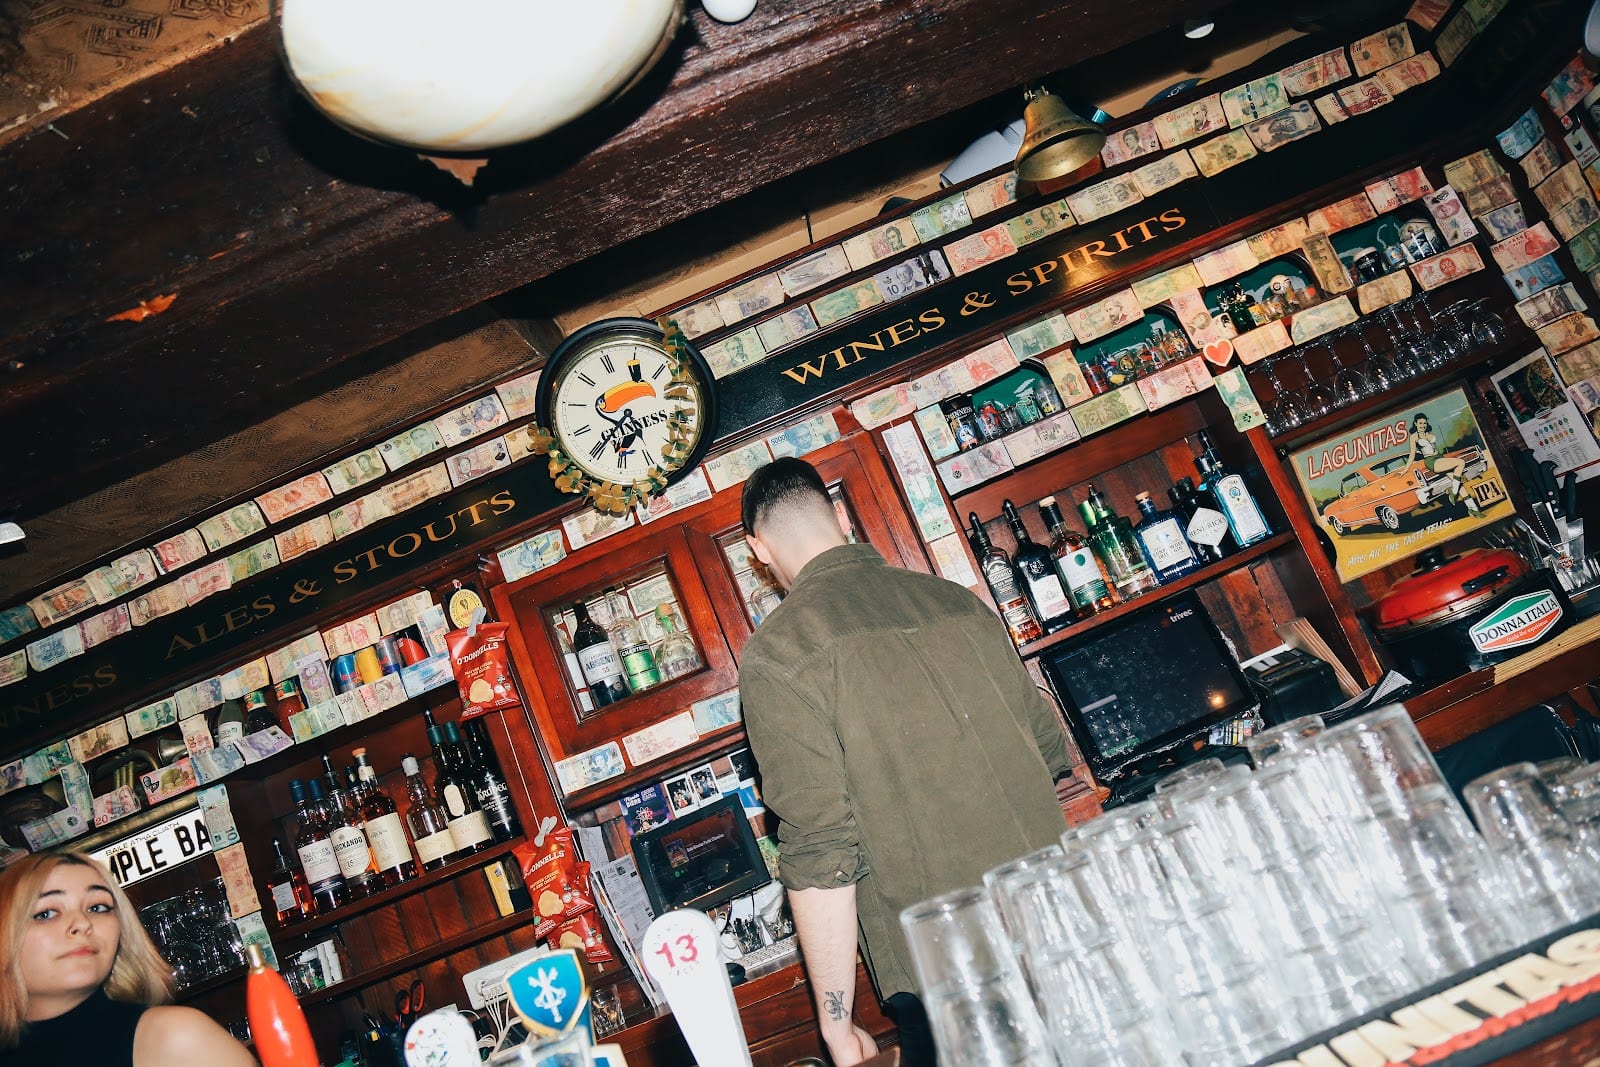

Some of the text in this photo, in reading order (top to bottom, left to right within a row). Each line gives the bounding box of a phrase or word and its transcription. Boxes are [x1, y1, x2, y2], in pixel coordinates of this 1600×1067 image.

[781, 207, 1187, 385] WINES & SPIRITS
[886, 283, 900, 296] 10
[1061, 331, 1072, 341] 20
[601, 409, 668, 441] GUINNESS
[1307, 420, 1409, 480] LAGUNITAS
[707, 460, 721, 471] 100
[1473, 481, 1501, 503] IPA
[209, 538, 221, 550] 20
[1403, 528, 1425, 546] TASTE
[163, 489, 517, 660] ALES & STOUTS
[1169, 607, 1194, 624] trivec
[1476, 598, 1558, 644] DONNA ITALIA
[457, 641, 499, 665] O'DONNELLS
[95, 814, 109, 826] 20
[110, 818, 212, 884] MPLE BA
[523, 850, 566, 879] ONNELLS
[656, 934, 698, 968] 13
[1264, 928, 1600, 1067] UNITAS
